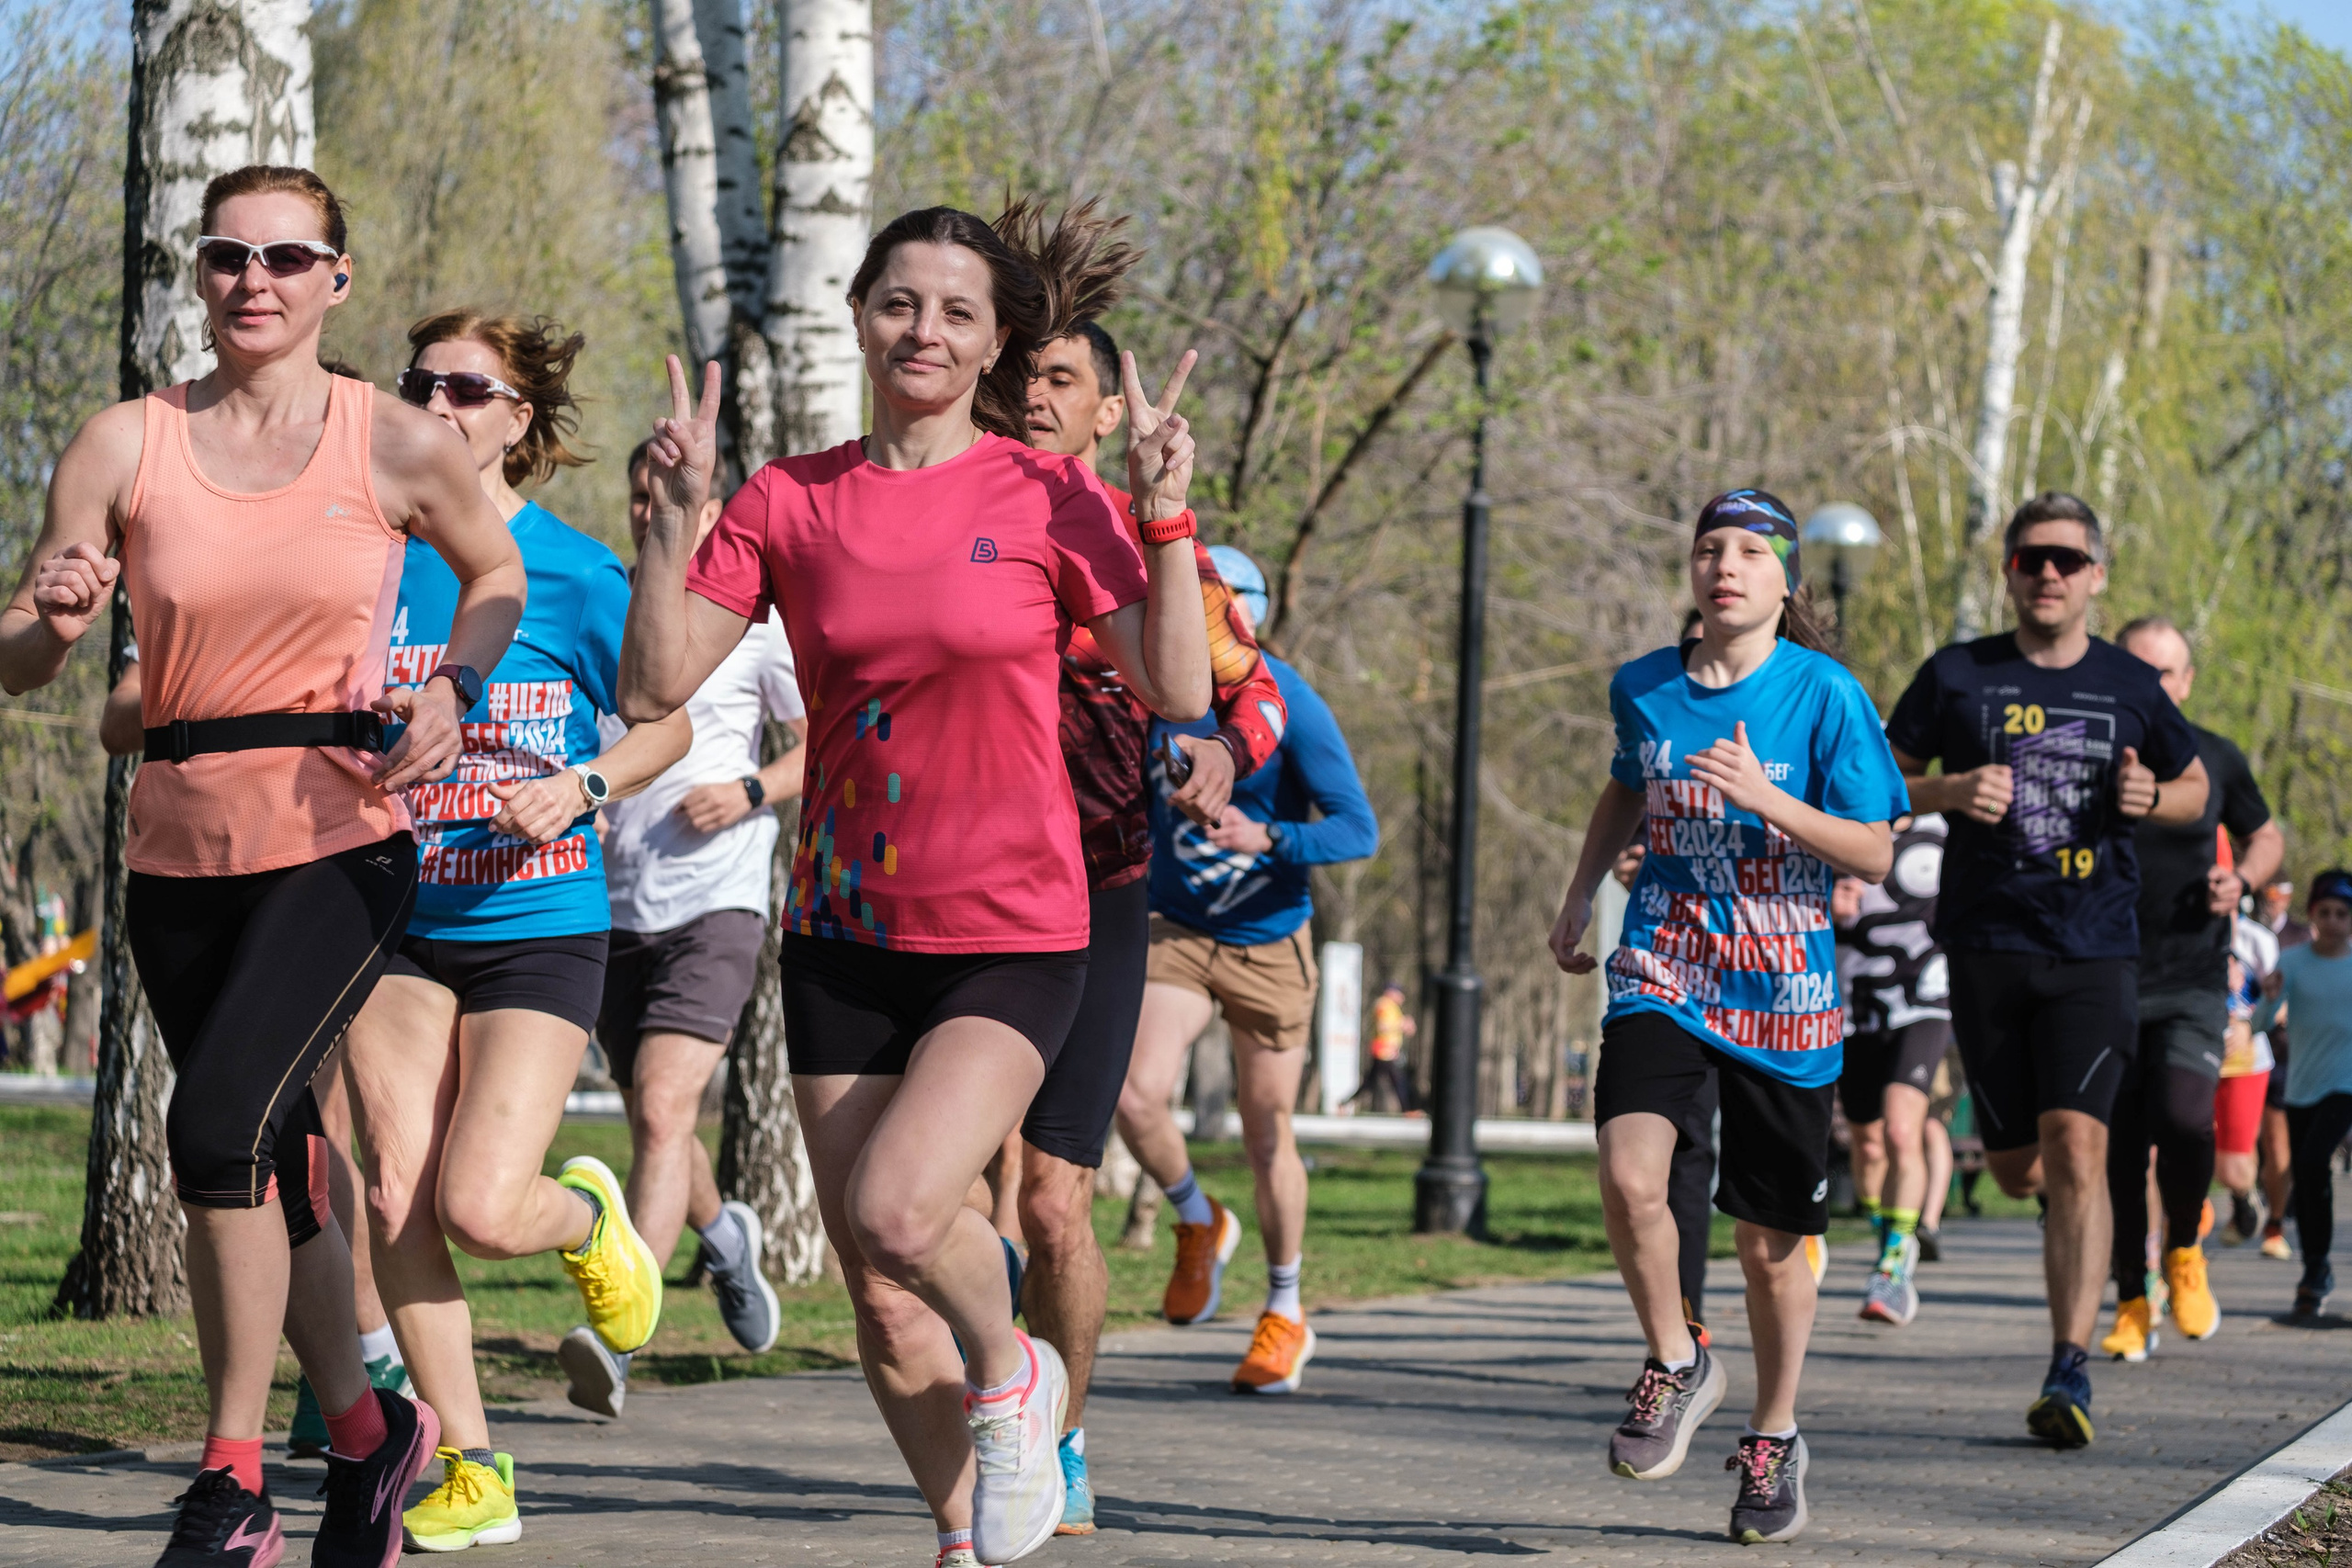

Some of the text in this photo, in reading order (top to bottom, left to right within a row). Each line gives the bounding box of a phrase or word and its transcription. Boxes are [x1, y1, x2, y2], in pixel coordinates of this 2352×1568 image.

[489, 681, 573, 721] #ЦЕЛЬ
[2004, 704, 2045, 734] 20
[419, 833, 588, 886] #ЕДИНСТВО
[2055, 848, 2095, 879] 19
[1772, 971, 1835, 1013] 2024
